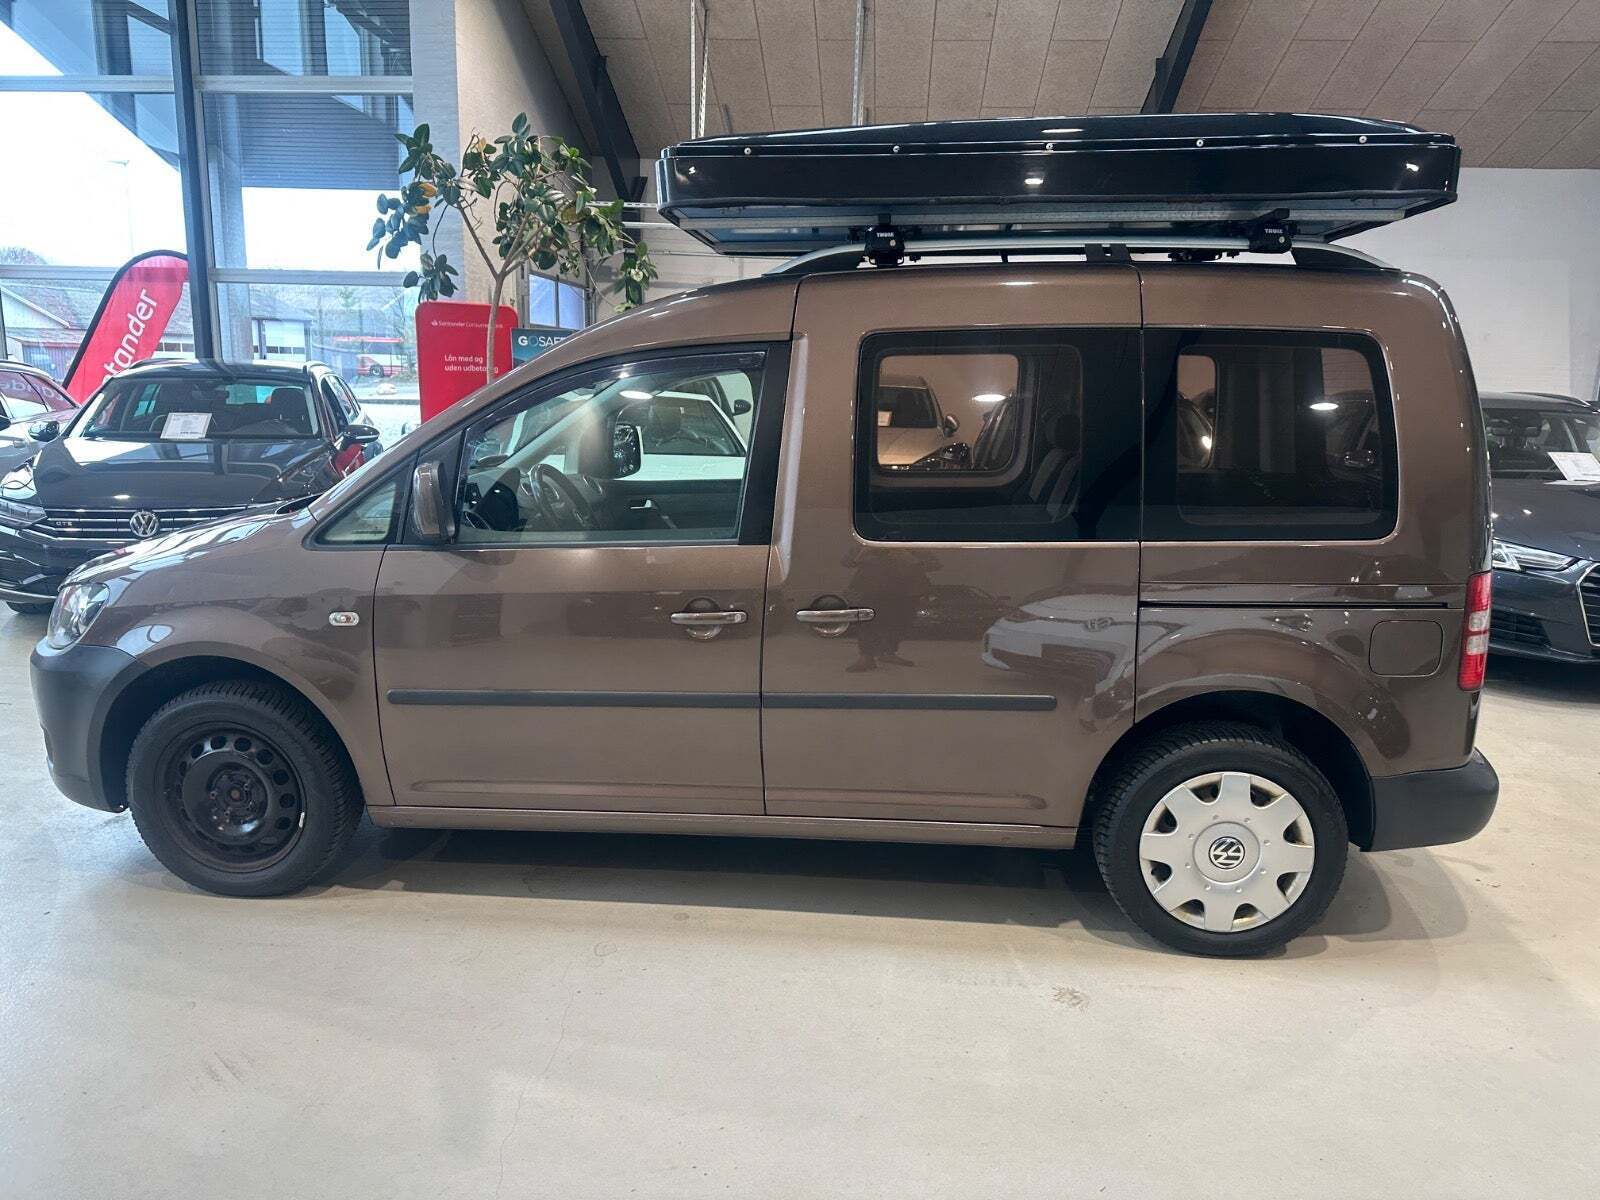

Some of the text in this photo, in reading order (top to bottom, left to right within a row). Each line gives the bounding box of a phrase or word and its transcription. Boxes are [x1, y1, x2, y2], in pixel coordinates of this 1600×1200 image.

[444, 353, 457, 362] Lån
[474, 356, 484, 365] og
[444, 364, 462, 372] uden
